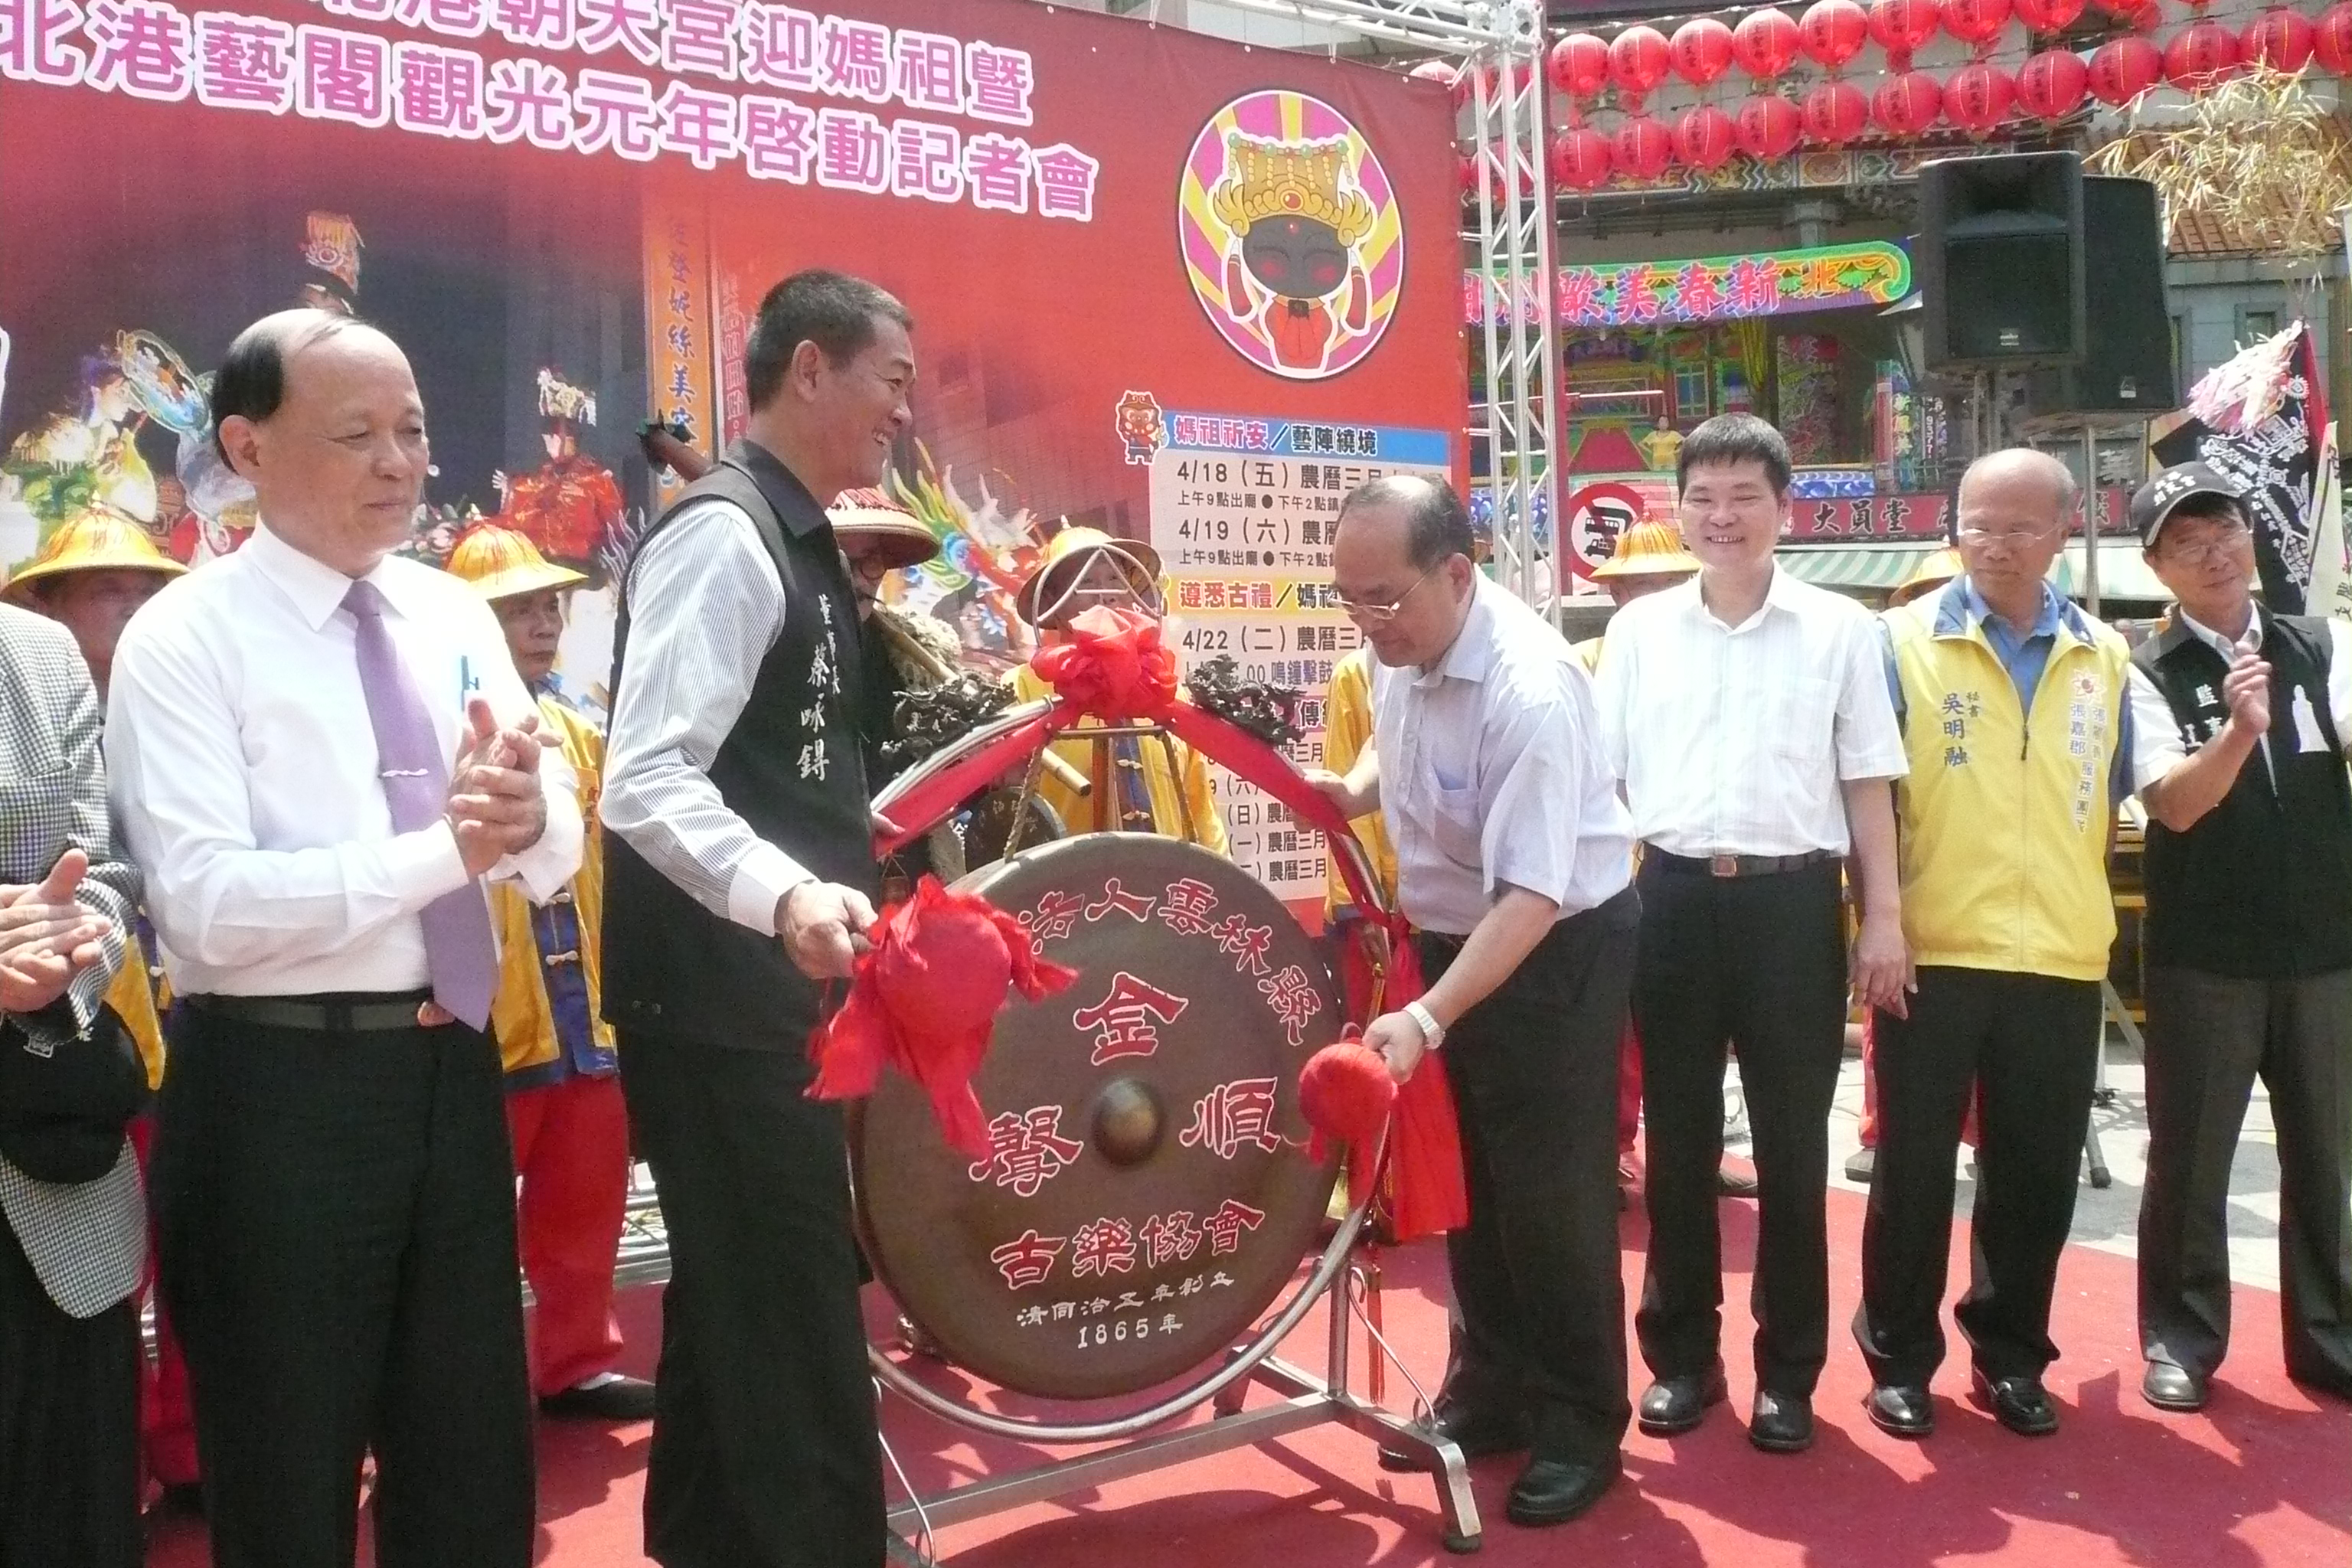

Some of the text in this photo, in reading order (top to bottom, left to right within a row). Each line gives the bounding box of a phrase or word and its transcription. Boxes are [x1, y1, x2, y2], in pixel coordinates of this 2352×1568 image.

[322, 0, 1034, 127] 朝天宮迎媽祖暨
[1073, 971, 1189, 1067] 金
